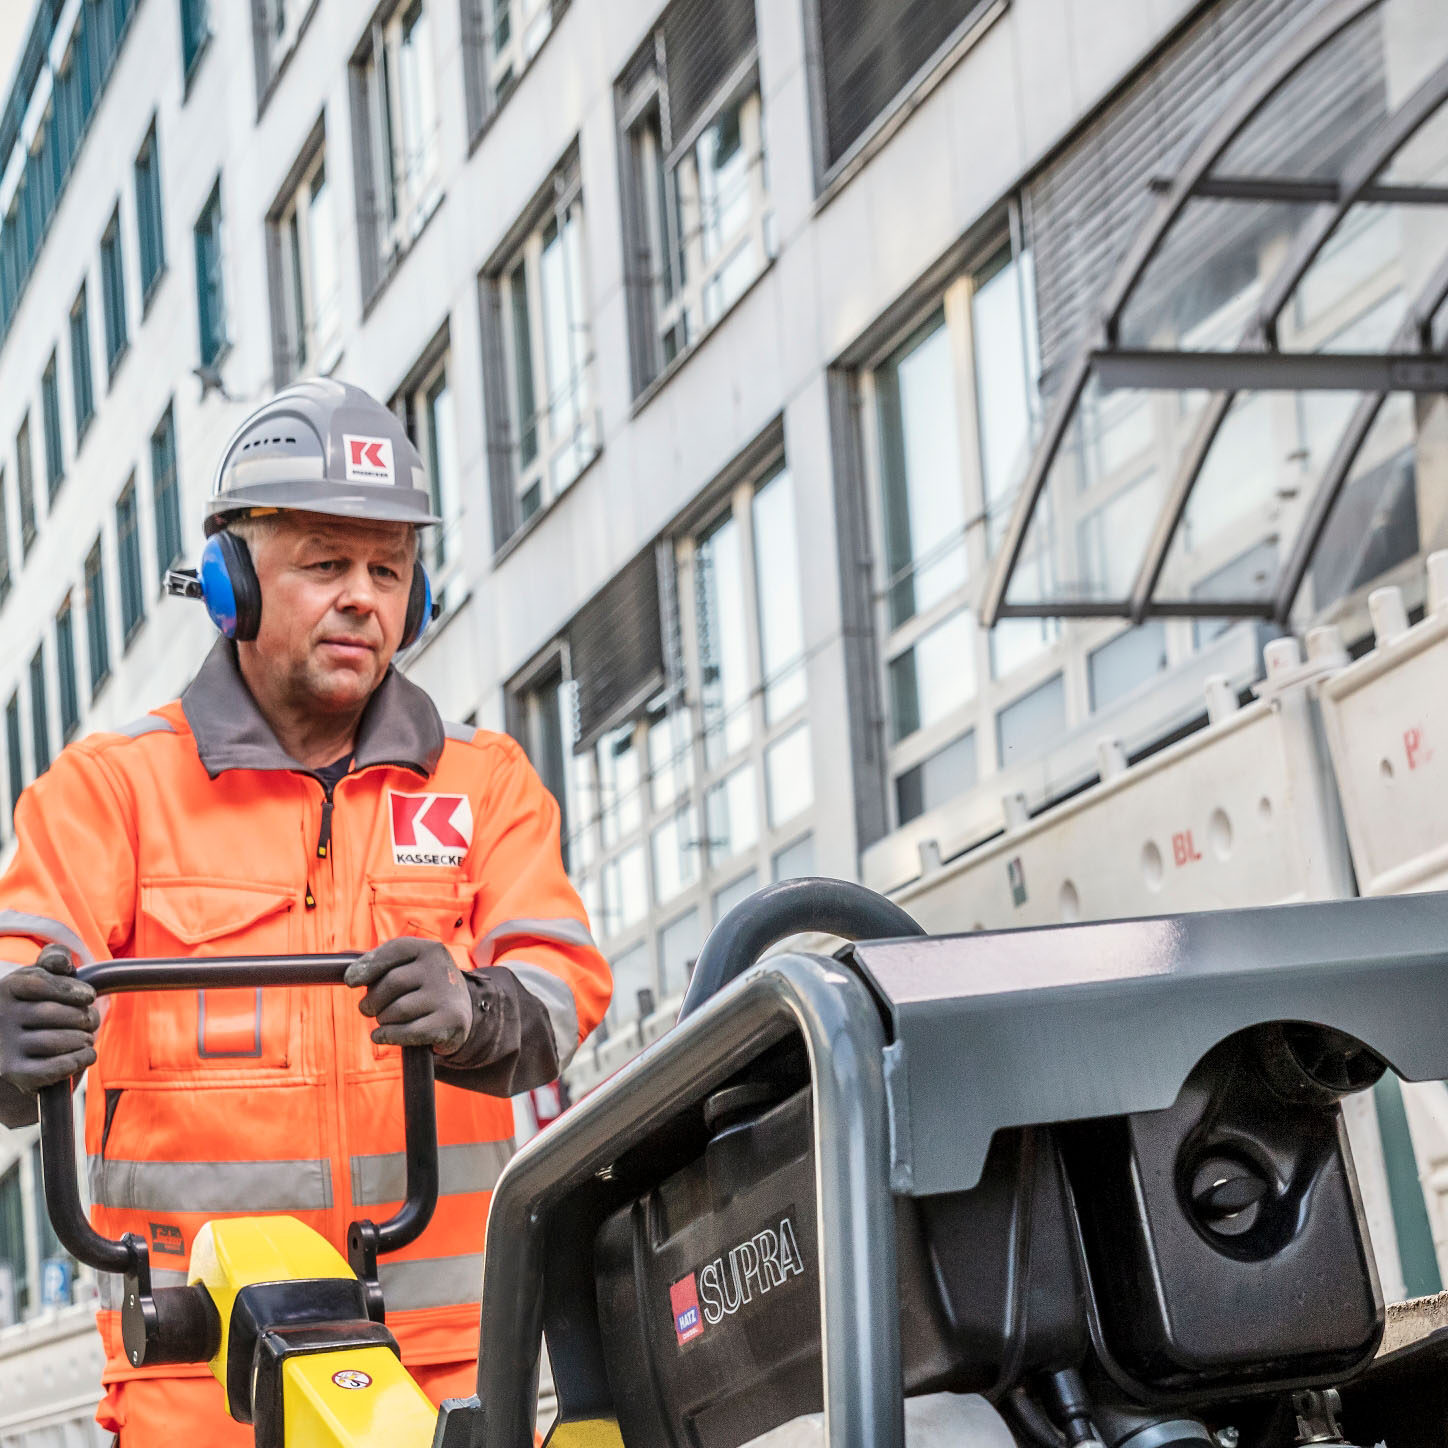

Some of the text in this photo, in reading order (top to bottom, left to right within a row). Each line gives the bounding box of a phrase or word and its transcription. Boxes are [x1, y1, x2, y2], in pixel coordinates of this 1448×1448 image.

[390, 793, 469, 848] K
[396, 854, 466, 867] KASSECKE
[700, 1218, 804, 1324] SUPRA
[678, 1309, 697, 1330] HATZ
